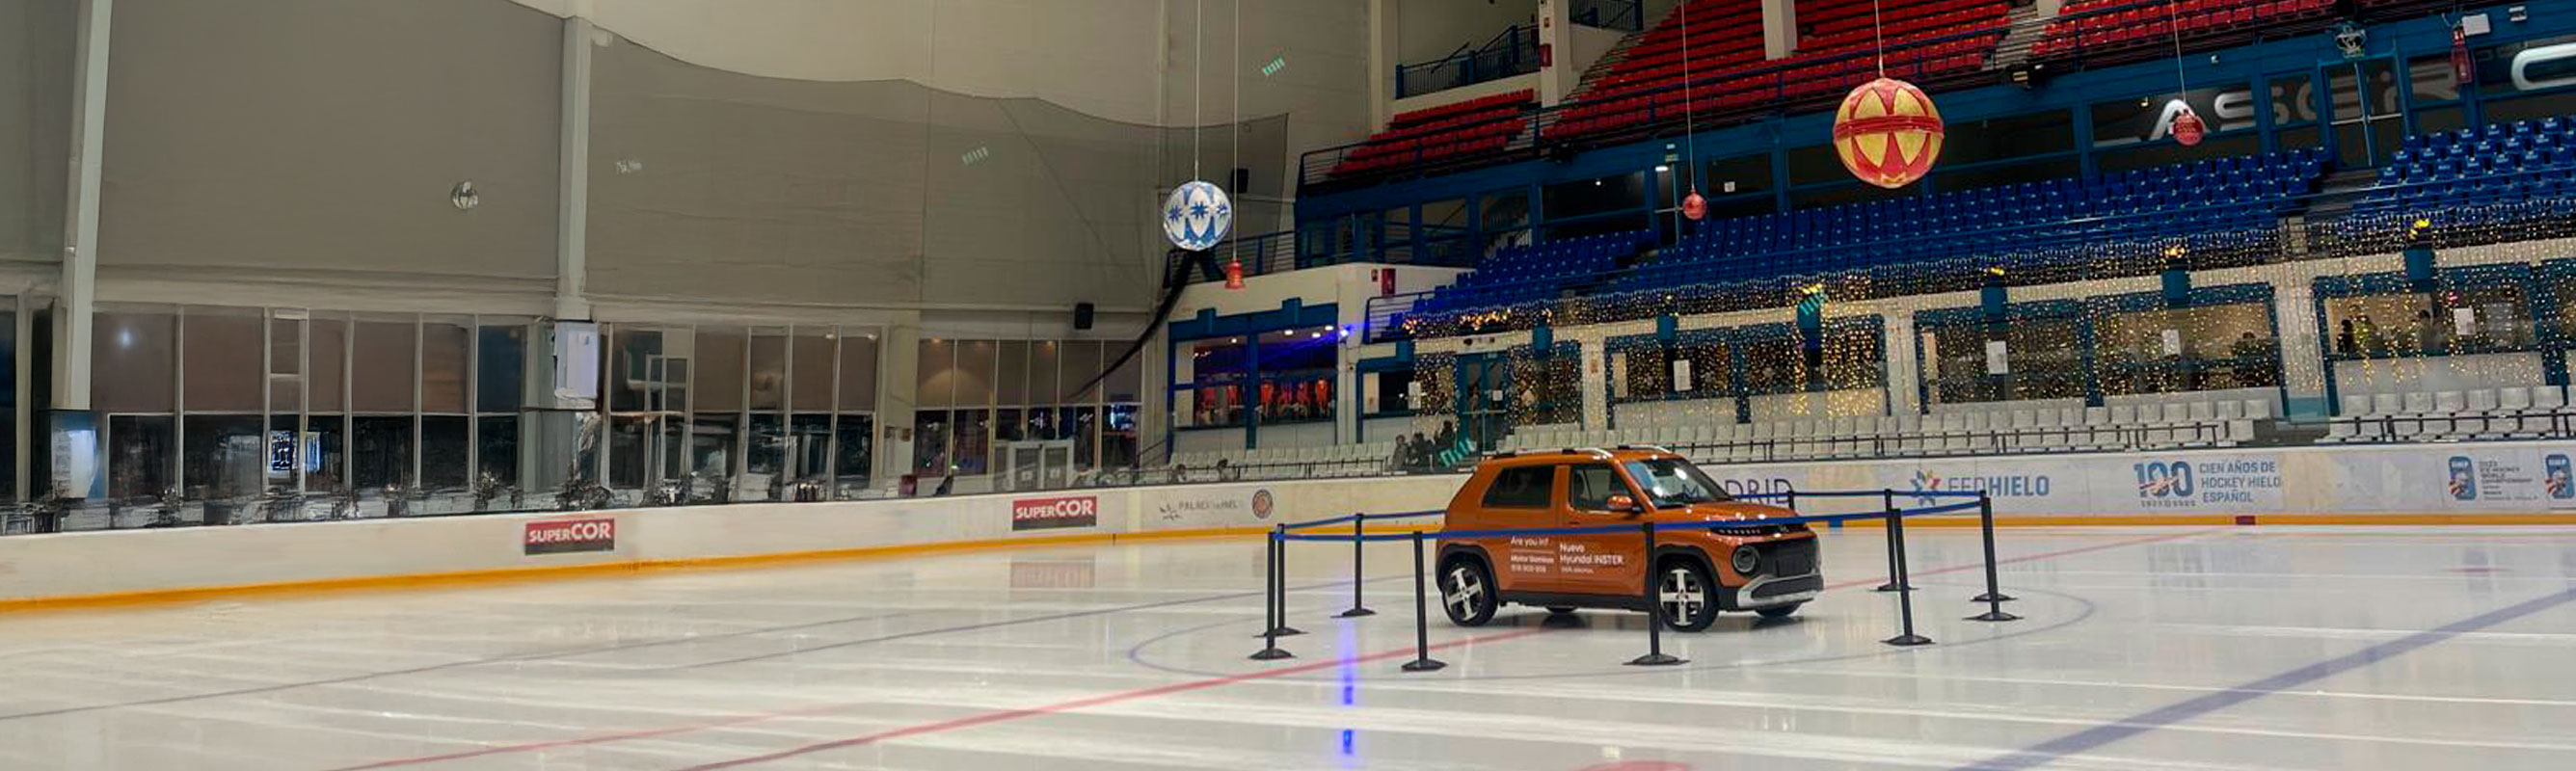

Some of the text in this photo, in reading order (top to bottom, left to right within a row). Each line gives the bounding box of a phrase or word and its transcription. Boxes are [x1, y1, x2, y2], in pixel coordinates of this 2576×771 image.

[2199, 460, 2275, 474] CIEN AÑOS DE
[2133, 461, 2194, 497] 100
[2202, 476, 2281, 488] HOCKEY HIELO
[2203, 490, 2253, 503] ESPAÑOL
[1015, 499, 1094, 519] SUPERCOR
[528, 521, 612, 543] SUPERCOR
[1511, 536, 1523, 545] Are
[1525, 537, 1538, 547] you
[1560, 543, 1585, 553] Nuevo
[1560, 554, 1592, 566] Hyundai
[1595, 555, 1623, 566] INSTER
